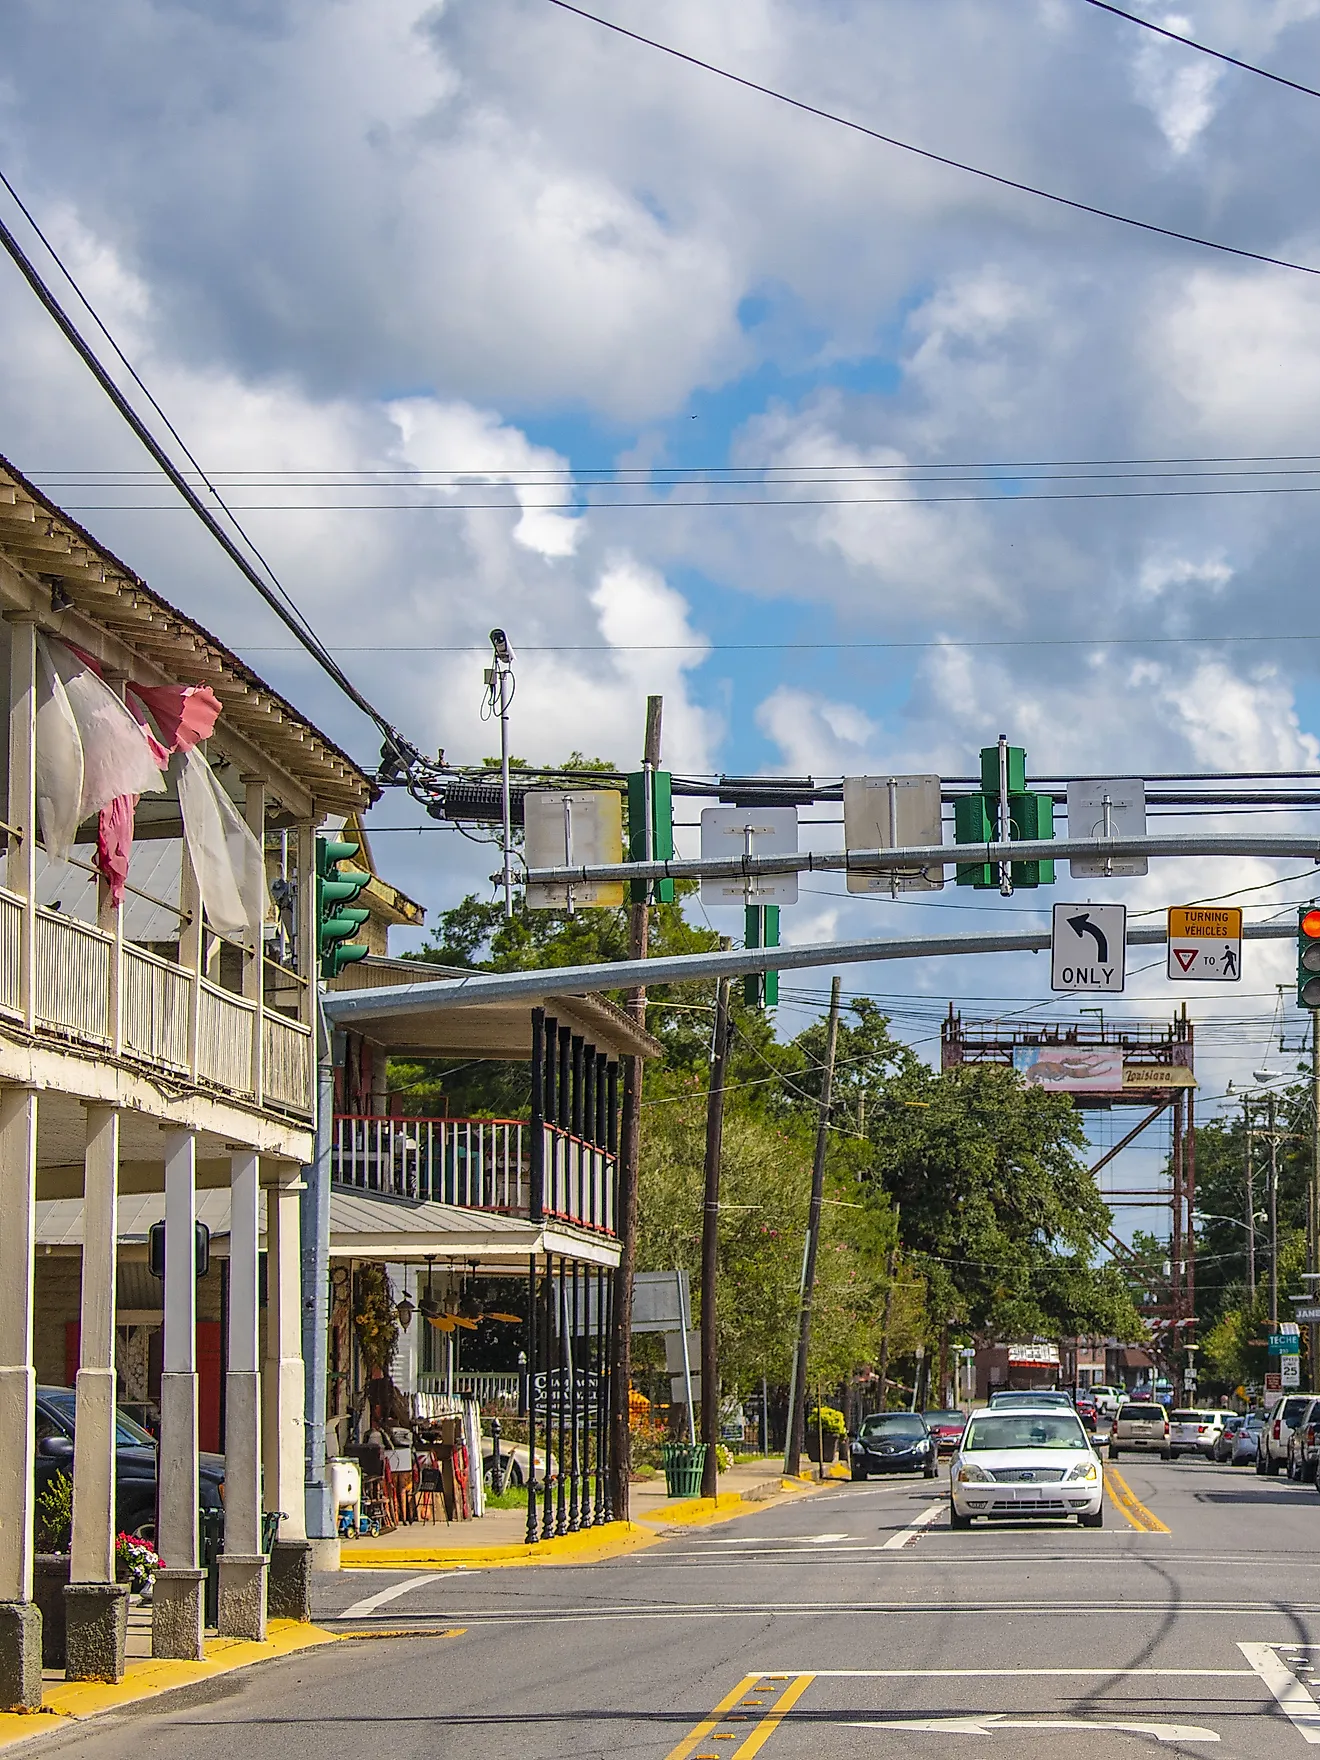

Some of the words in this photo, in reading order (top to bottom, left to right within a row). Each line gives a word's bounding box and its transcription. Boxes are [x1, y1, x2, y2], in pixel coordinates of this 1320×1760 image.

[1184, 911, 1229, 922] TURNING
[1184, 925, 1228, 936] VEHICLES
[1203, 956, 1216, 965] TO
[1062, 967, 1114, 984] ONLY
[1270, 1335, 1297, 1345] TECHE
[1283, 1366, 1298, 1376] 25
